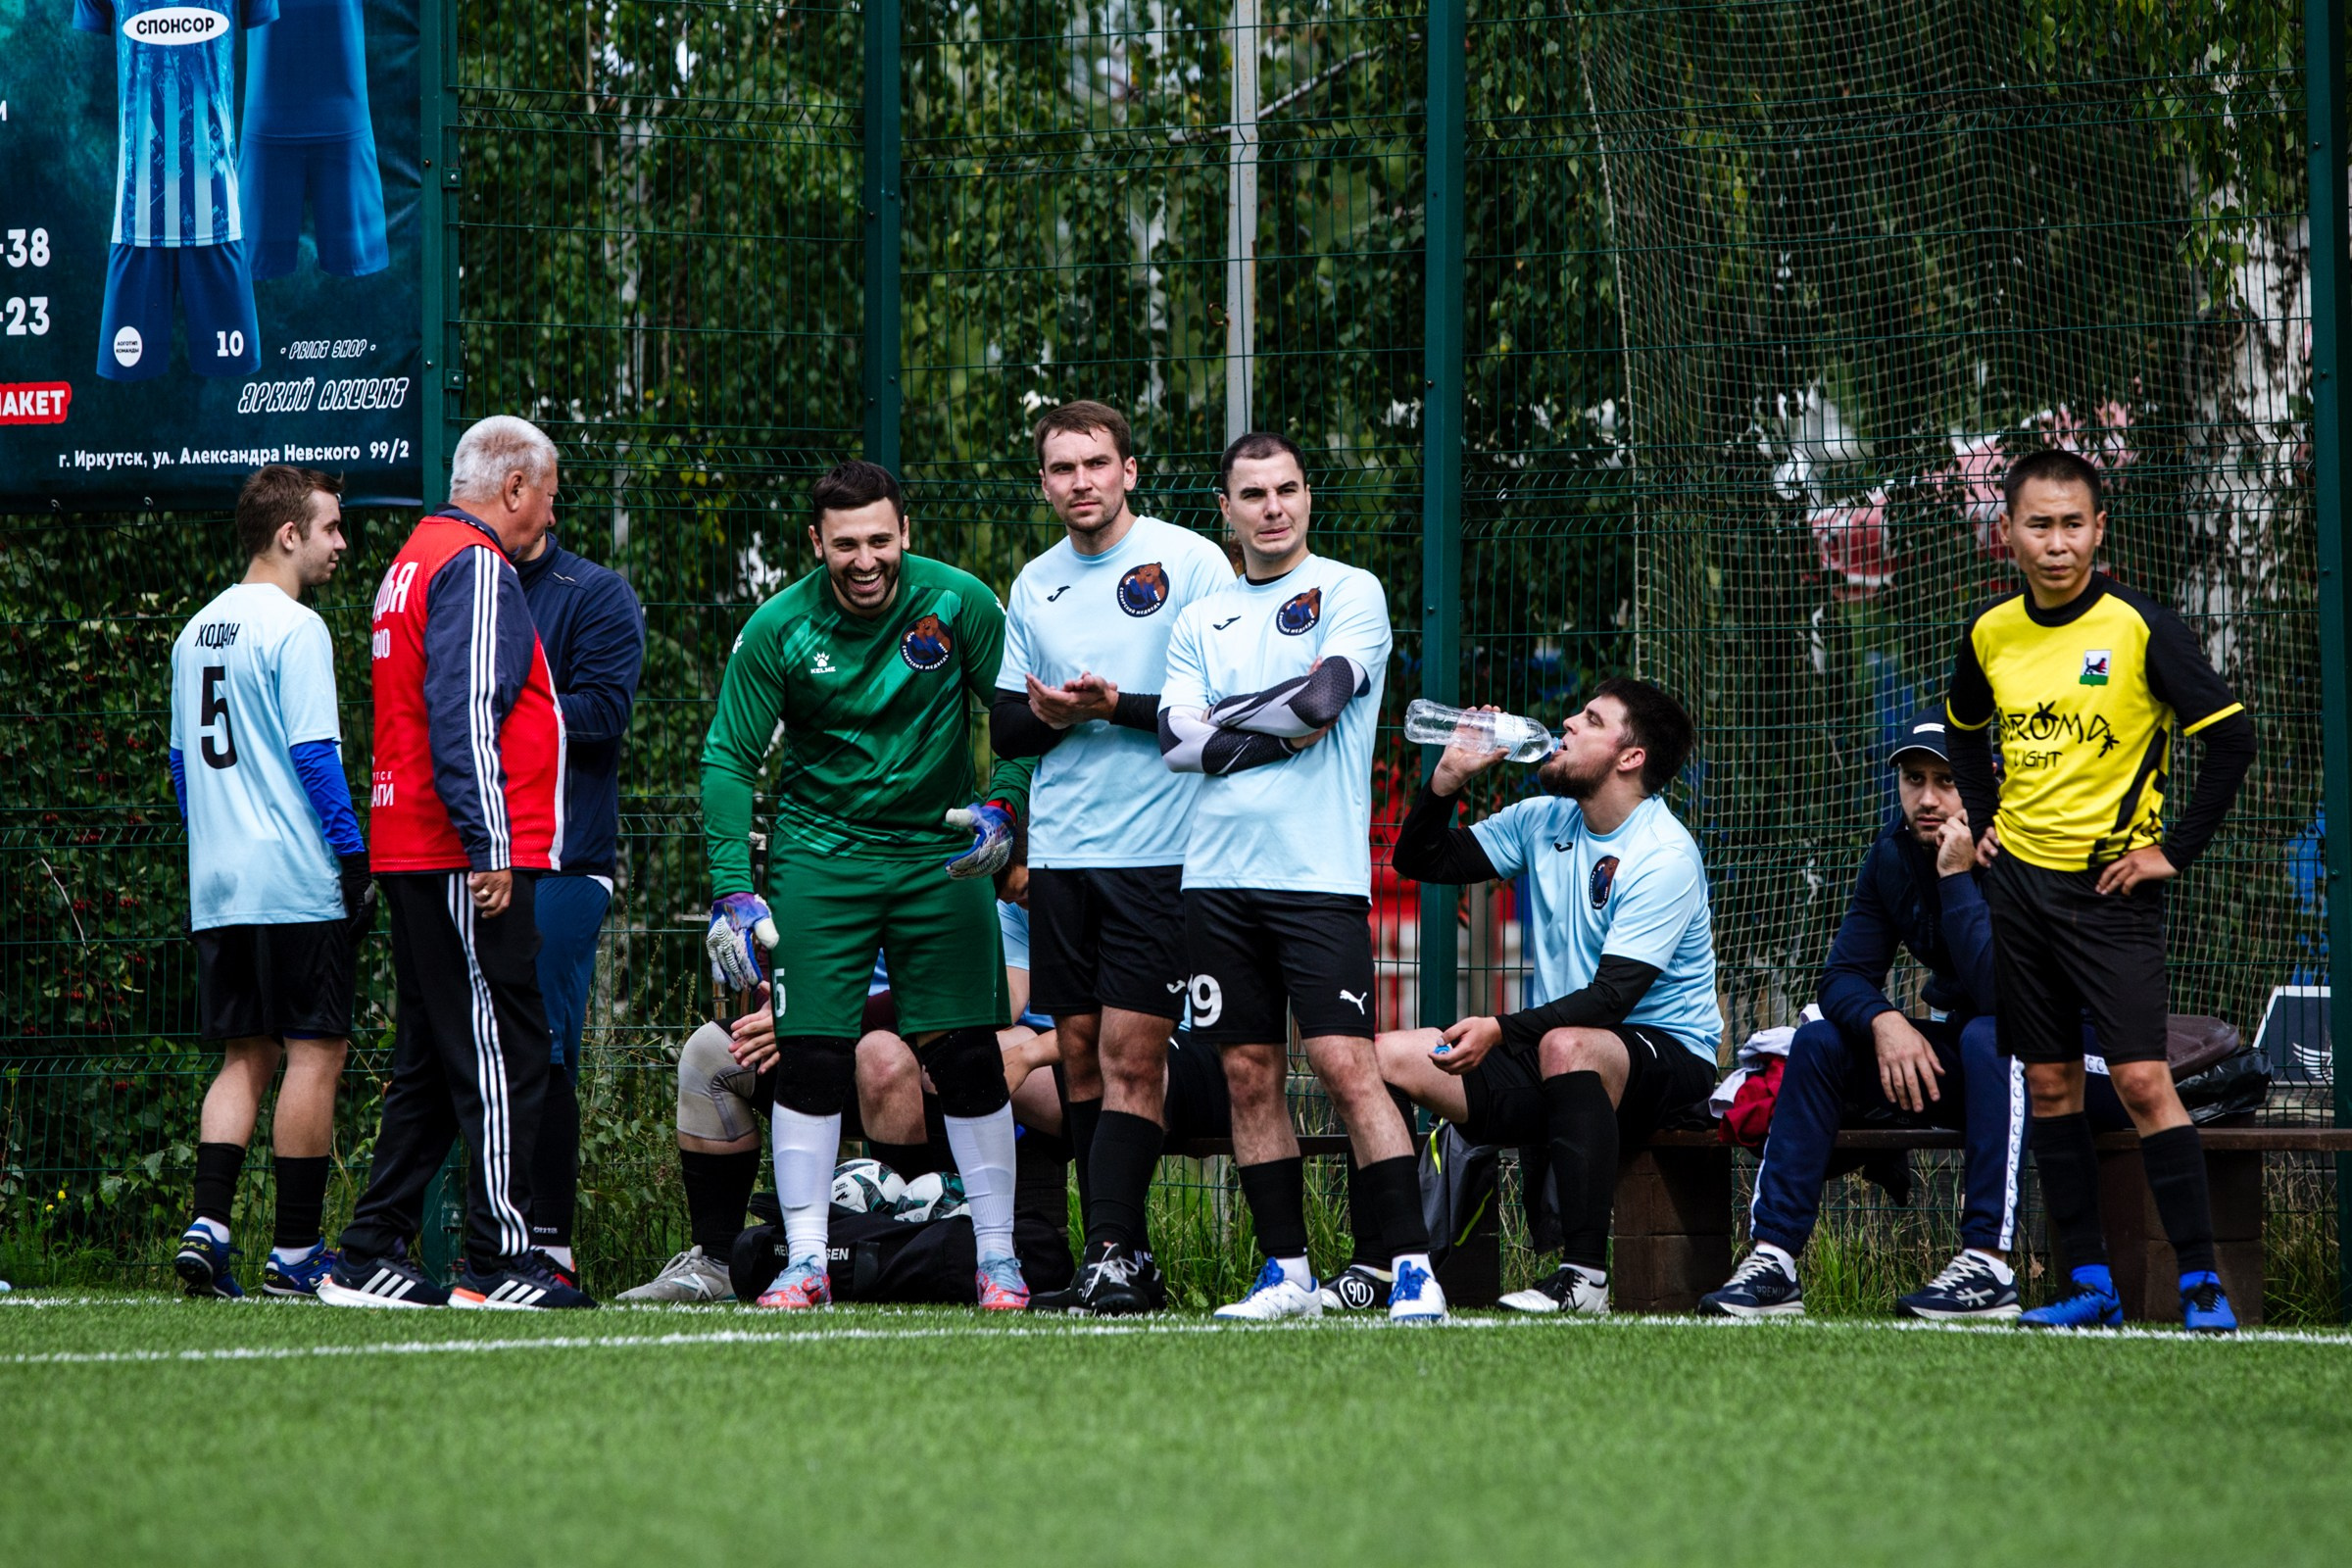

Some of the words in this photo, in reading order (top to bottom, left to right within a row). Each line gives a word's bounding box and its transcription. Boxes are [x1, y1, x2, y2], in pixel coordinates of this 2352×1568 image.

[136, 17, 215, 34] СПОНСОР
[217, 329, 244, 357] 10
[289, 340, 330, 360] PRINT
[331, 338, 368, 358] SHOP
[0, 389, 66, 416] АКЕТ
[237, 376, 316, 414] ЯРКИЙ
[318, 376, 410, 411] АКЦЕНТ
[59, 454, 71, 467] г.
[74, 450, 147, 471] Иркутск,
[153, 451, 174, 469] ул.
[179, 447, 279, 466] Александра
[284, 444, 361, 462] Невского
[369, 438, 410, 464] 99/2
[810, 665, 837, 674] KELME
[201, 665, 238, 769] 5
[2014, 750, 2064, 770] LIGHT
[1188, 973, 1223, 1027] 9
[825, 1247, 851, 1261] SEN
[1347, 1281, 1367, 1303] 90
